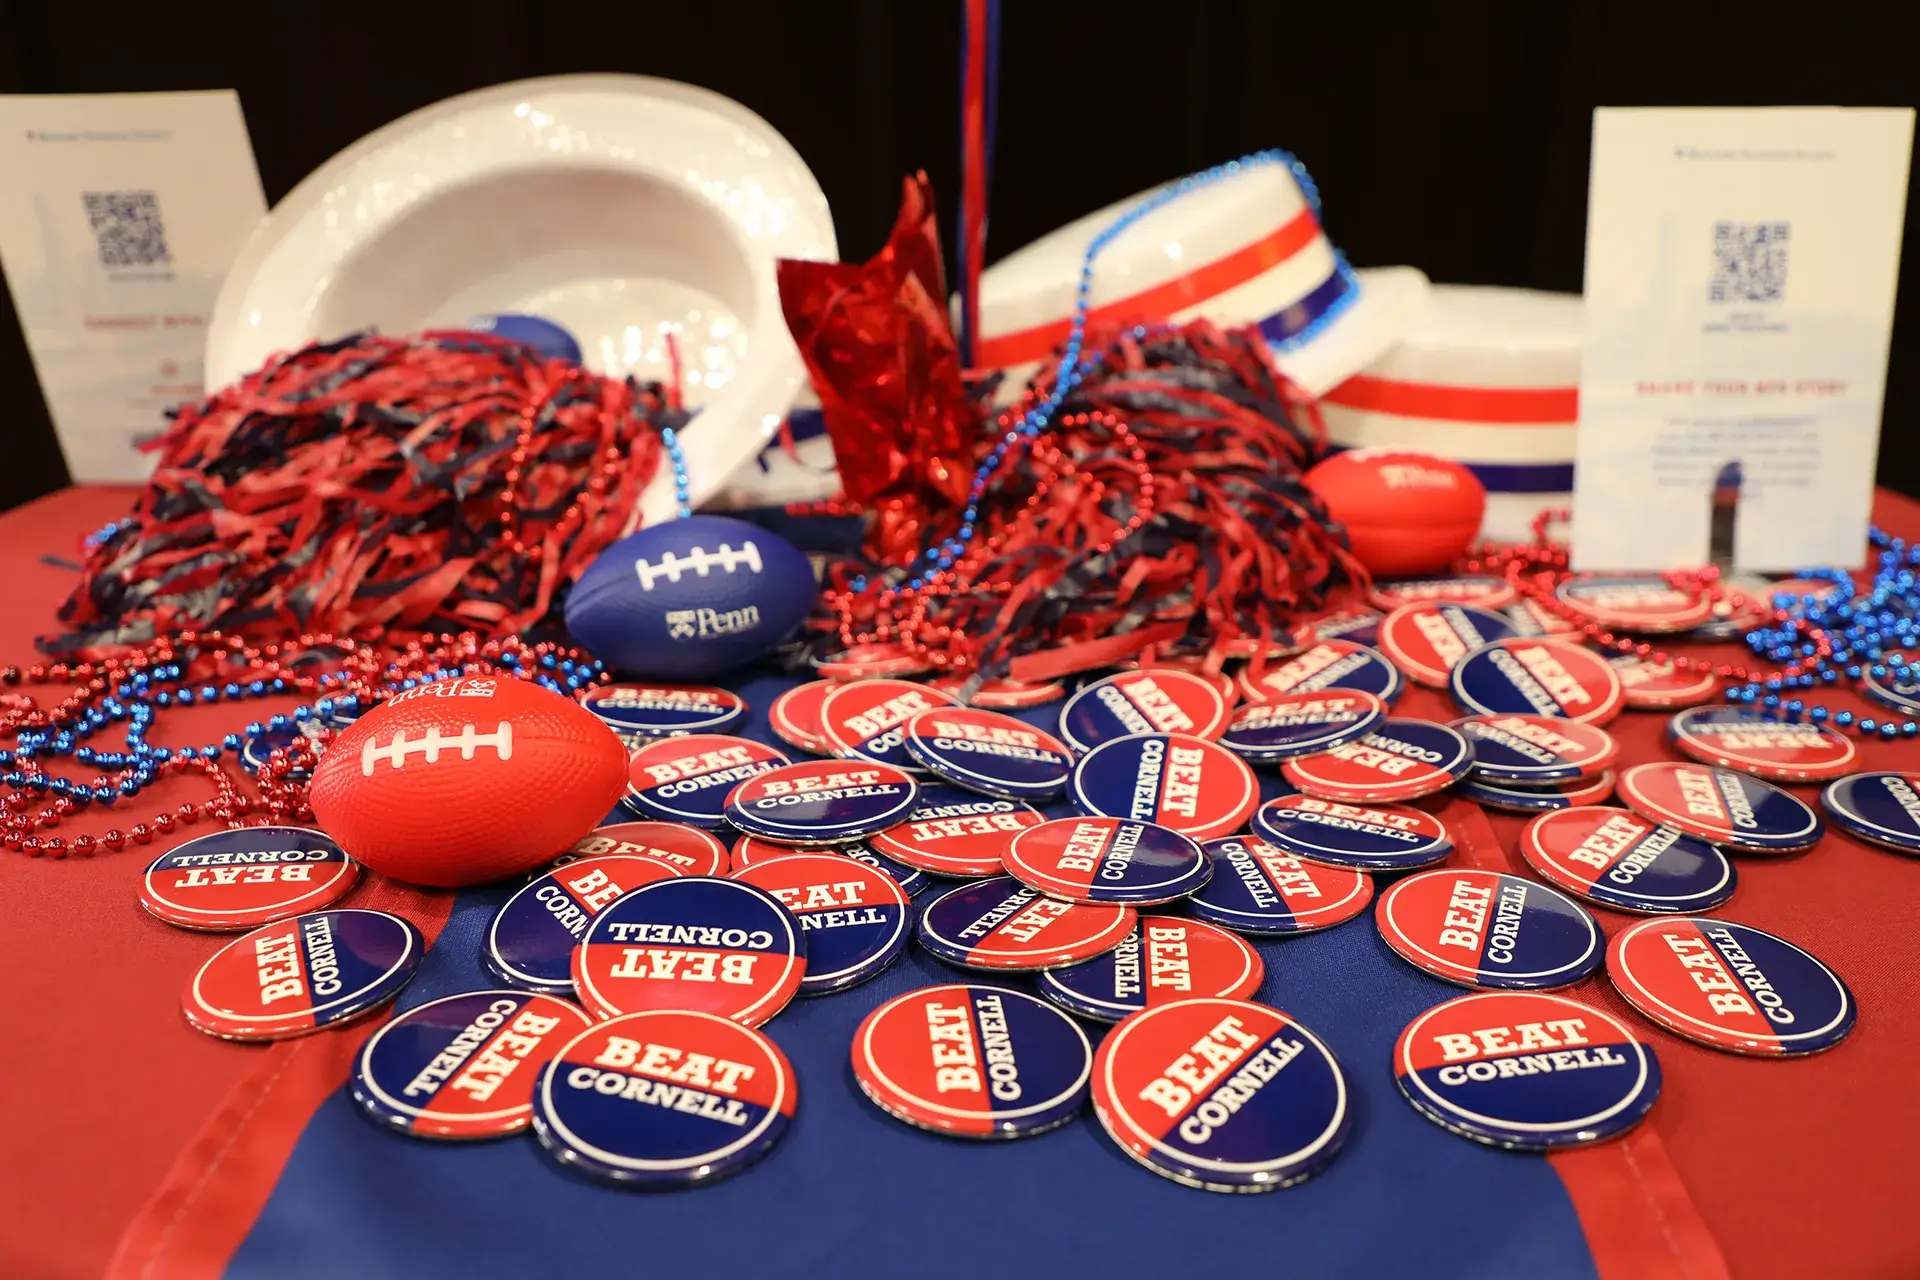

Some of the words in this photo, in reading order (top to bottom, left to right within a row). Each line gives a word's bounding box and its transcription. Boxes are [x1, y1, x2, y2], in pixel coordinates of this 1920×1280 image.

[697, 605, 760, 637] Penn
[388, 679, 464, 707] Penn
[611, 688, 720, 702] BEAT
[1488, 649, 1560, 718] CORNELL
[1515, 646, 1591, 704] BEAT
[597, 699, 725, 714] CORNELL
[843, 691, 932, 739] BEAT
[1096, 685, 1154, 734] CORNE
[1122, 677, 1194, 732] BEAT
[1230, 710, 1359, 732] CORNELL
[1245, 698, 1356, 719] BEAT
[932, 720, 1039, 748] BEAT
[933, 737, 1062, 764] CORNELL
[1359, 732, 1443, 763] CORN
[1491, 717, 1586, 752] BEAT
[644, 746, 753, 783] BEAT
[657, 761, 781, 798] CORNELL
[762, 770, 881, 797] BEAT
[1131, 739, 1165, 819] CORNELL
[1162, 747, 1204, 818] BEAT
[756, 784, 901, 809] CORNELL
[910, 801, 1015, 821] CORNE
[1295, 798, 1420, 830] BEAT
[1674, 769, 1725, 819] BEAT
[1716, 773, 1758, 828] CORNELL
[910, 813, 1027, 841] BEAT
[1057, 823, 1111, 872] BEAT
[1276, 809, 1420, 843] CORNELL
[1568, 815, 1646, 870] BEAT
[171, 849, 330, 867] CORNELL
[175, 864, 315, 888] BEAT
[1101, 824, 1144, 880] CORNELL
[1220, 842, 1279, 909] CORNELL
[1252, 843, 1322, 898] BEAT
[535, 885, 589, 939] CORN
[568, 868, 625, 912] BE
[768, 881, 866, 911] EAT
[957, 888, 1039, 939] ORNELL
[608, 922, 774, 949] CORNELL
[799, 908, 887, 931] NELL
[998, 900, 1075, 943] EAT
[1438, 880, 1492, 951] BEAT
[1488, 885, 1527, 964] CORNELL
[255, 933, 304, 1006] BEAT
[305, 917, 343, 996] CORNELL
[610, 948, 758, 985] BEAT
[1114, 925, 1141, 999] ORNELL
[1149, 926, 1192, 992] BEAT
[1662, 933, 1756, 1016] BEAT
[1708, 928, 1795, 1025] CORNELL
[403, 999, 518, 1100] CORNELL
[451, 1011, 561, 1102] BEAT
[925, 1002, 983, 1094] BEAT
[975, 995, 1022, 1101] CORNELL
[1434, 1018, 1589, 1062] BEAT
[594, 1036, 756, 1095] BEAT
[1138, 1015, 1259, 1118] BEAT
[1439, 1047, 1626, 1086] CORNELL
[567, 1067, 750, 1127] CORNELL
[1178, 1036, 1305, 1145] CORNELL
